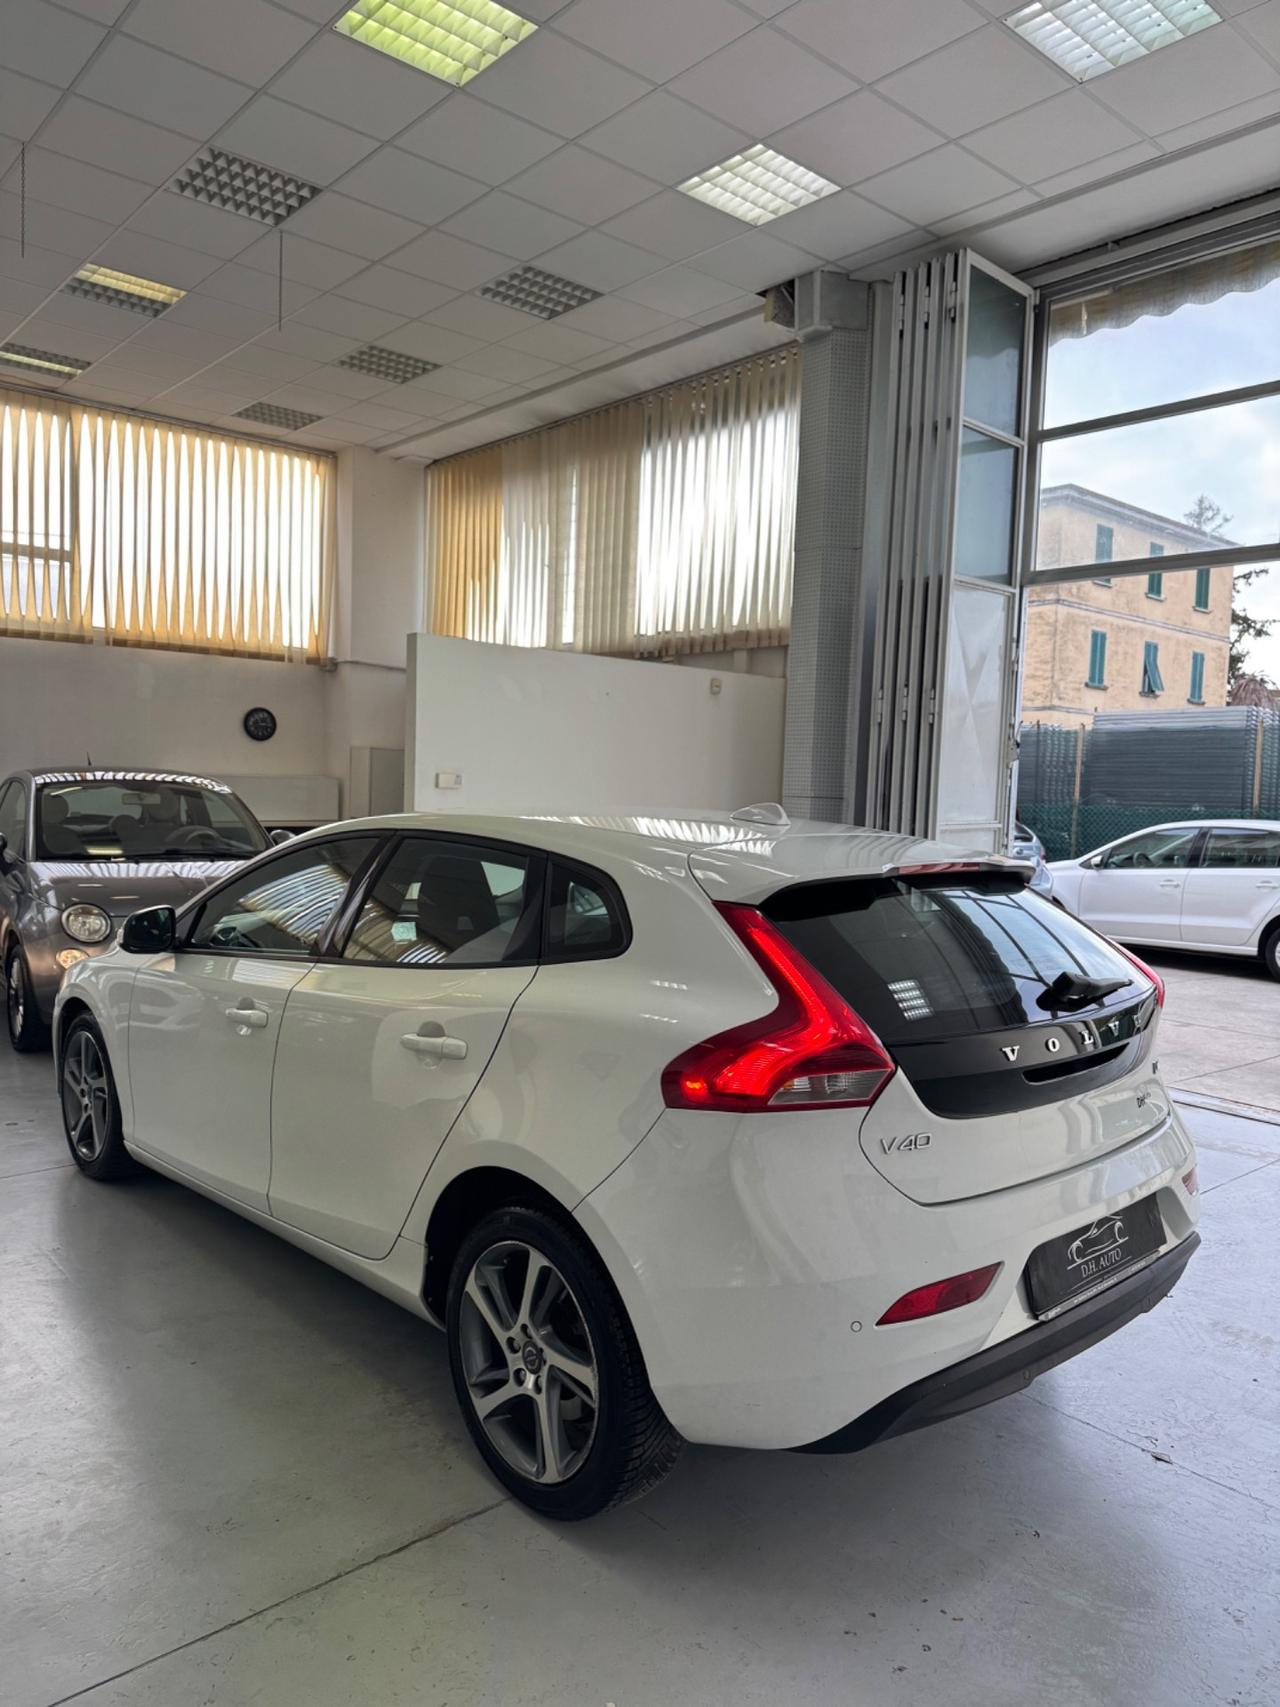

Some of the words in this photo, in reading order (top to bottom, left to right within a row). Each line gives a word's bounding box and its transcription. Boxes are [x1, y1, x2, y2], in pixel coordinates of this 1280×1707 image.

[880, 1131, 932, 1154] V40
[1081, 1261, 1098, 1277] D.H.
[1099, 1248, 1122, 1269] AUTO
